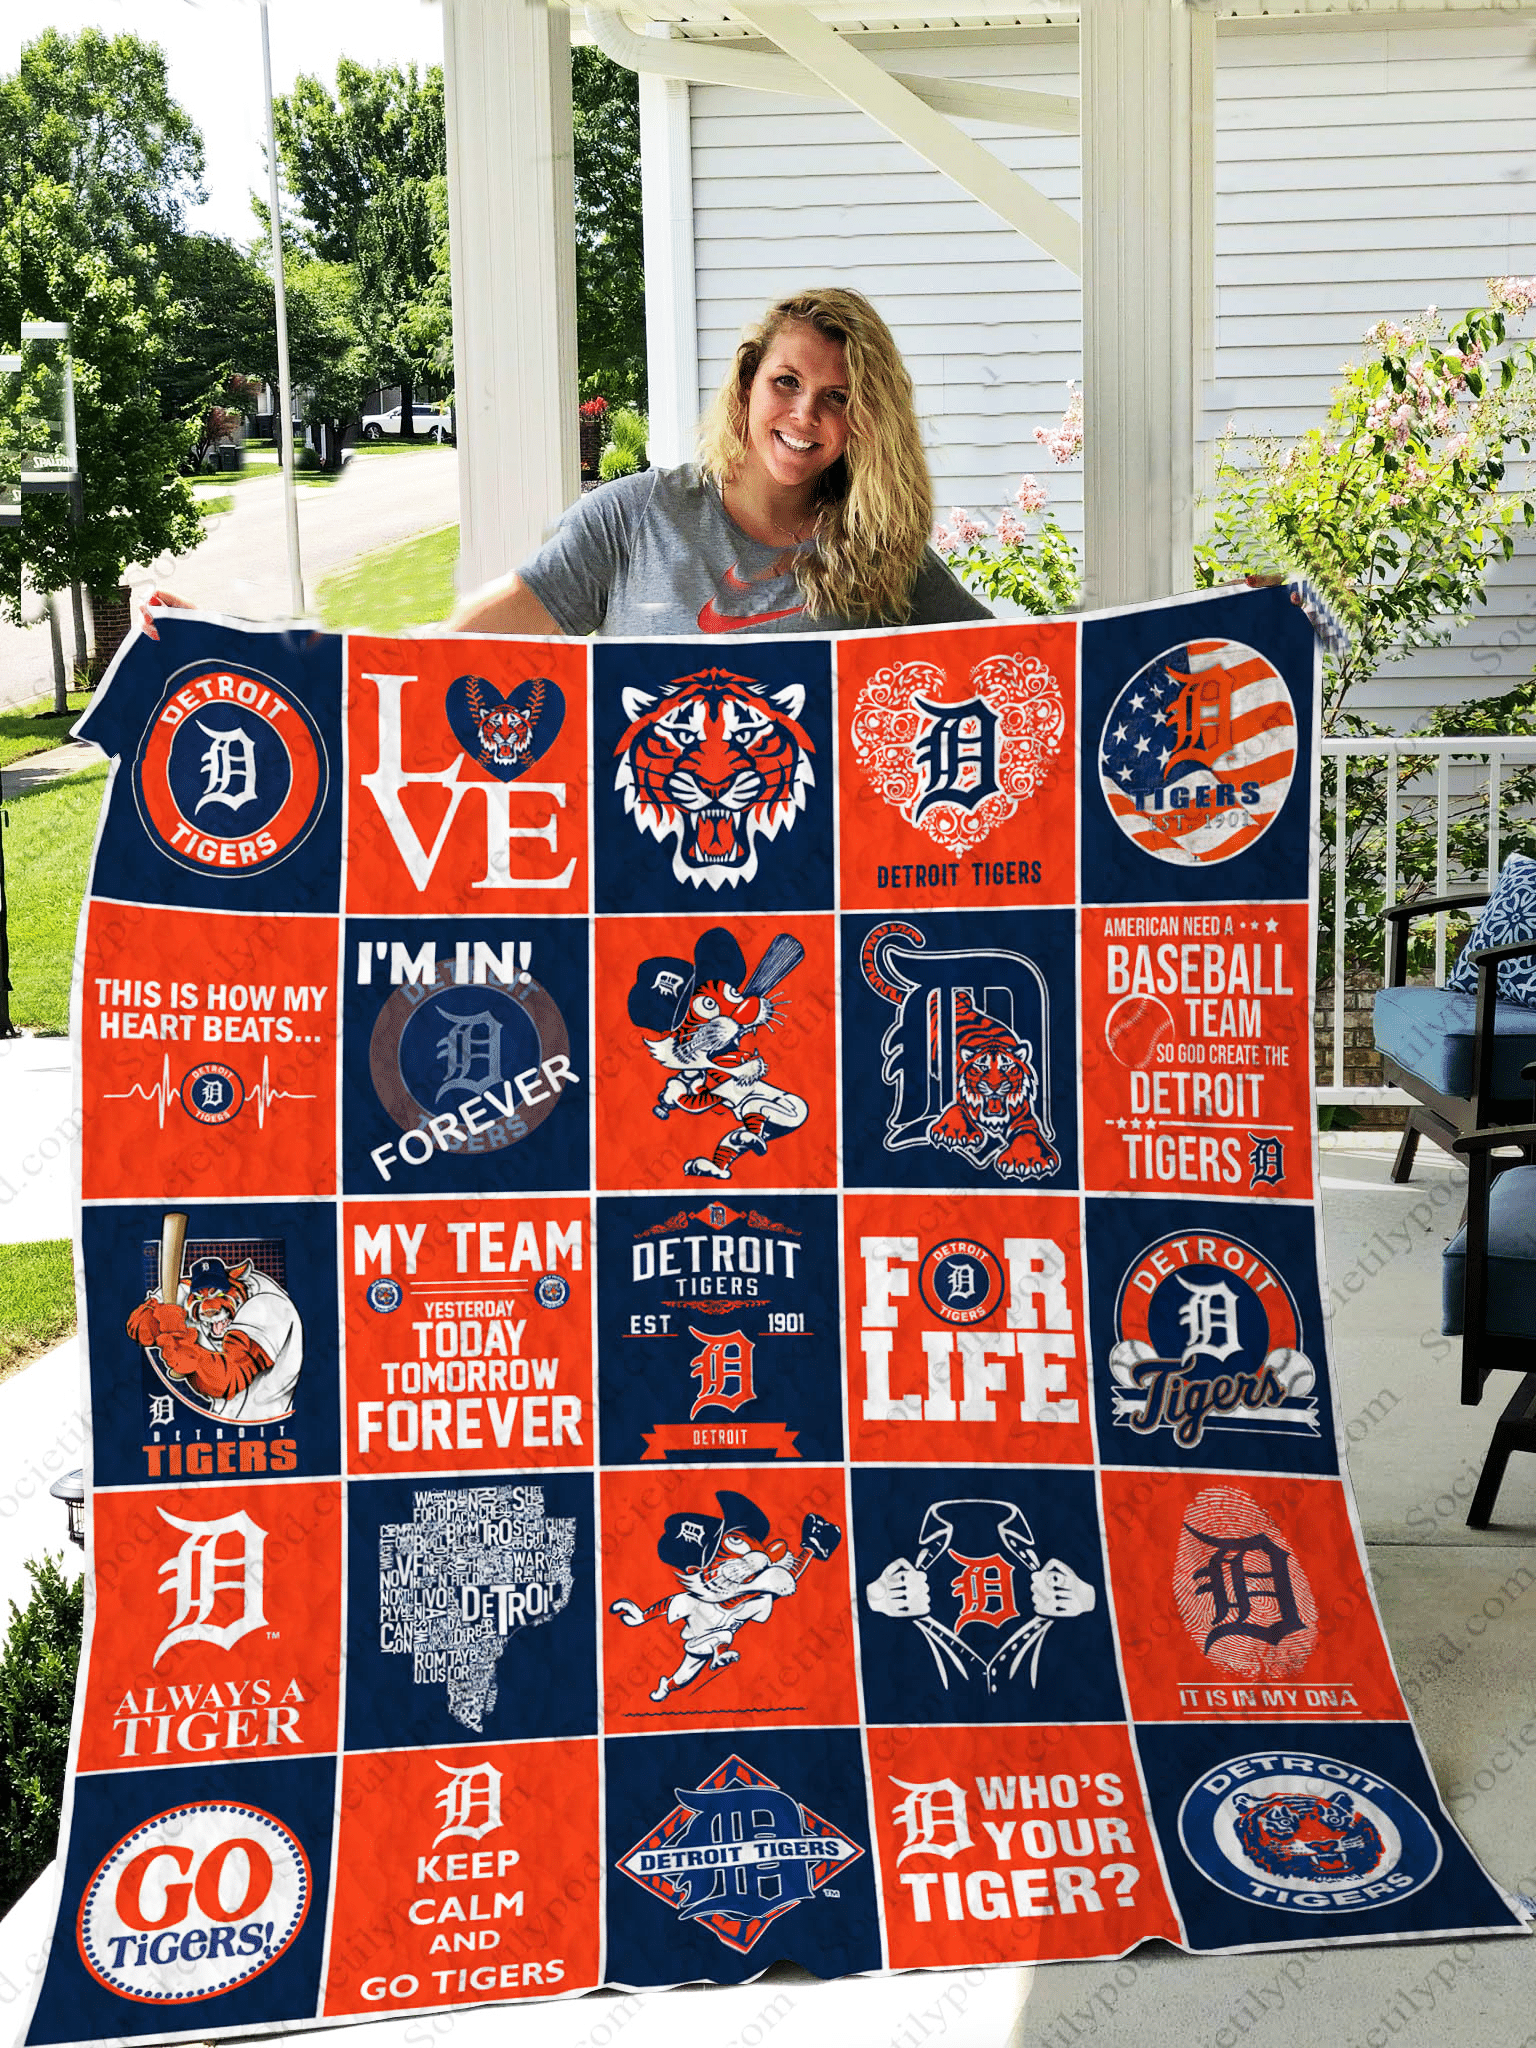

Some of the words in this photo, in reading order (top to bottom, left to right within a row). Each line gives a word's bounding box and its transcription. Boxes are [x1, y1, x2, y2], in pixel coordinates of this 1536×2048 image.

[160, 675, 289, 726] DETROIT
[1130, 781, 1261, 812] TIGERS
[170, 821, 279, 867] TIGERS
[878, 863, 960, 889] DETROIT
[972, 860, 1042, 886] TIGERS
[1104, 916, 1179, 937] AMERICAN
[1183, 916, 1220, 936] NEED
[1224, 915, 1234, 935] A
[357, 941, 437, 986] I'M
[454, 941, 532, 985] IN!
[1107, 944, 1294, 996] BASEBALL
[95, 979, 161, 1008] THIS
[170, 983, 199, 1009] IS
[204, 983, 277, 1012] HOW
[283, 985, 328, 1012] MY
[101, 1012, 197, 1041] HEART
[203, 1015, 321, 1043] BEATS...
[1184, 998, 1261, 1038] TEAM
[1156, 1043, 1174, 1062] SO
[1178, 1043, 1205, 1064] GOD
[1209, 1044, 1259, 1065] CREATE
[1263, 1045, 1289, 1066] THE
[1130, 1070, 1265, 1118] DETROIT
[370, 1054, 580, 1182] FOREVER
[1122, 1134, 1242, 1184] TIGERS
[354, 1223, 427, 1276] MY
[447, 1220, 583, 1273] TEAM
[631, 1235, 801, 1283] DETROIT
[932, 1243, 989, 1261] DETROIT
[1132, 1237, 1278, 1295] DETROIT
[675, 1276, 759, 1298] TIGERS
[423, 1299, 516, 1319] YESTERDAY
[630, 1314, 671, 1335] EST
[768, 1312, 804, 1333] 1901
[940, 1305, 986, 1322] TIGERS
[413, 1320, 524, 1359] TODAY
[381, 1357, 559, 1395] TOMORROW
[860, 1330, 1080, 1424] LIFE
[1129, 1353, 1287, 1449] Tigers
[153, 1425, 285, 1443] DETROIT
[357, 1393, 584, 1453] FOREVER
[693, 1429, 747, 1445] DETROIT
[142, 1439, 297, 1477] TIGERS
[461, 1582, 557, 1636] DETROIT
[114, 1680, 272, 1717] ALWAYS
[279, 1678, 305, 1704] A
[1179, 1689, 1199, 1706] IT
[1206, 1689, 1228, 1706] IS
[1232, 1690, 1257, 1707] IN
[1262, 1689, 1298, 1706] MY
[1305, 1690, 1358, 1706] DNA
[112, 1703, 305, 1758] TIGER
[975, 1772, 1124, 1811] WHO'S
[1202, 1755, 1386, 1798] DETROIT
[640, 1846, 743, 1872] DETROIT
[754, 1840, 840, 1859] TIGERS
[981, 1817, 1135, 1862] YOUR
[115, 1838, 273, 1931] GO
[417, 1849, 520, 1884] KEEP
[408, 1890, 524, 1926] CALM
[900, 1862, 1141, 1923] TIGER?
[1248, 1872, 1415, 1908] TIGERS
[428, 1929, 501, 1955] AND
[360, 1974, 419, 2001] GO
[431, 1958, 567, 1992] TIGERS
